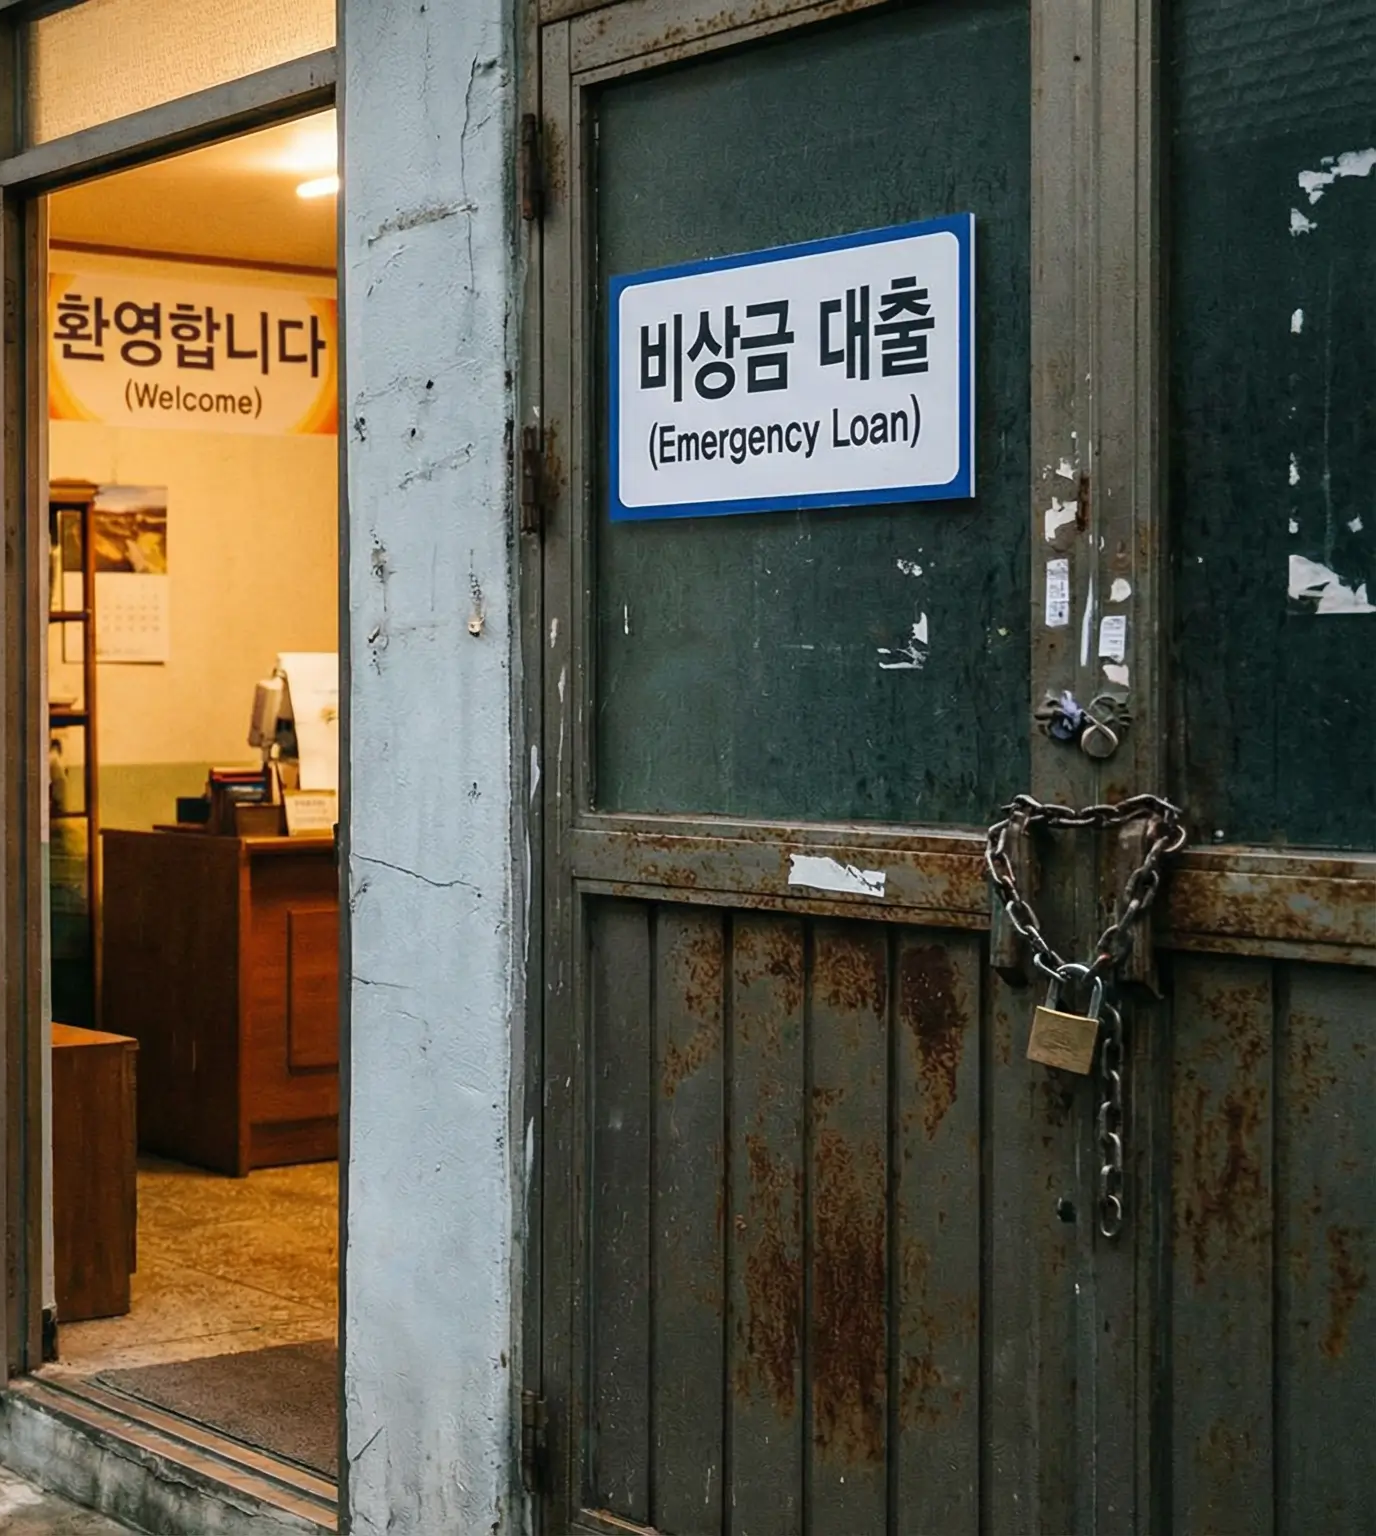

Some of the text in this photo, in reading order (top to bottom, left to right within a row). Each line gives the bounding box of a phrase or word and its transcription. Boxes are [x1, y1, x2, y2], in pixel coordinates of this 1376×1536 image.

[53, 293, 327, 379] 환영합니다
[640, 275, 935, 403] 비상금 대출
[125, 378, 263, 419] (Welcome)
[649, 393, 921, 471] (Emergency Loan)
